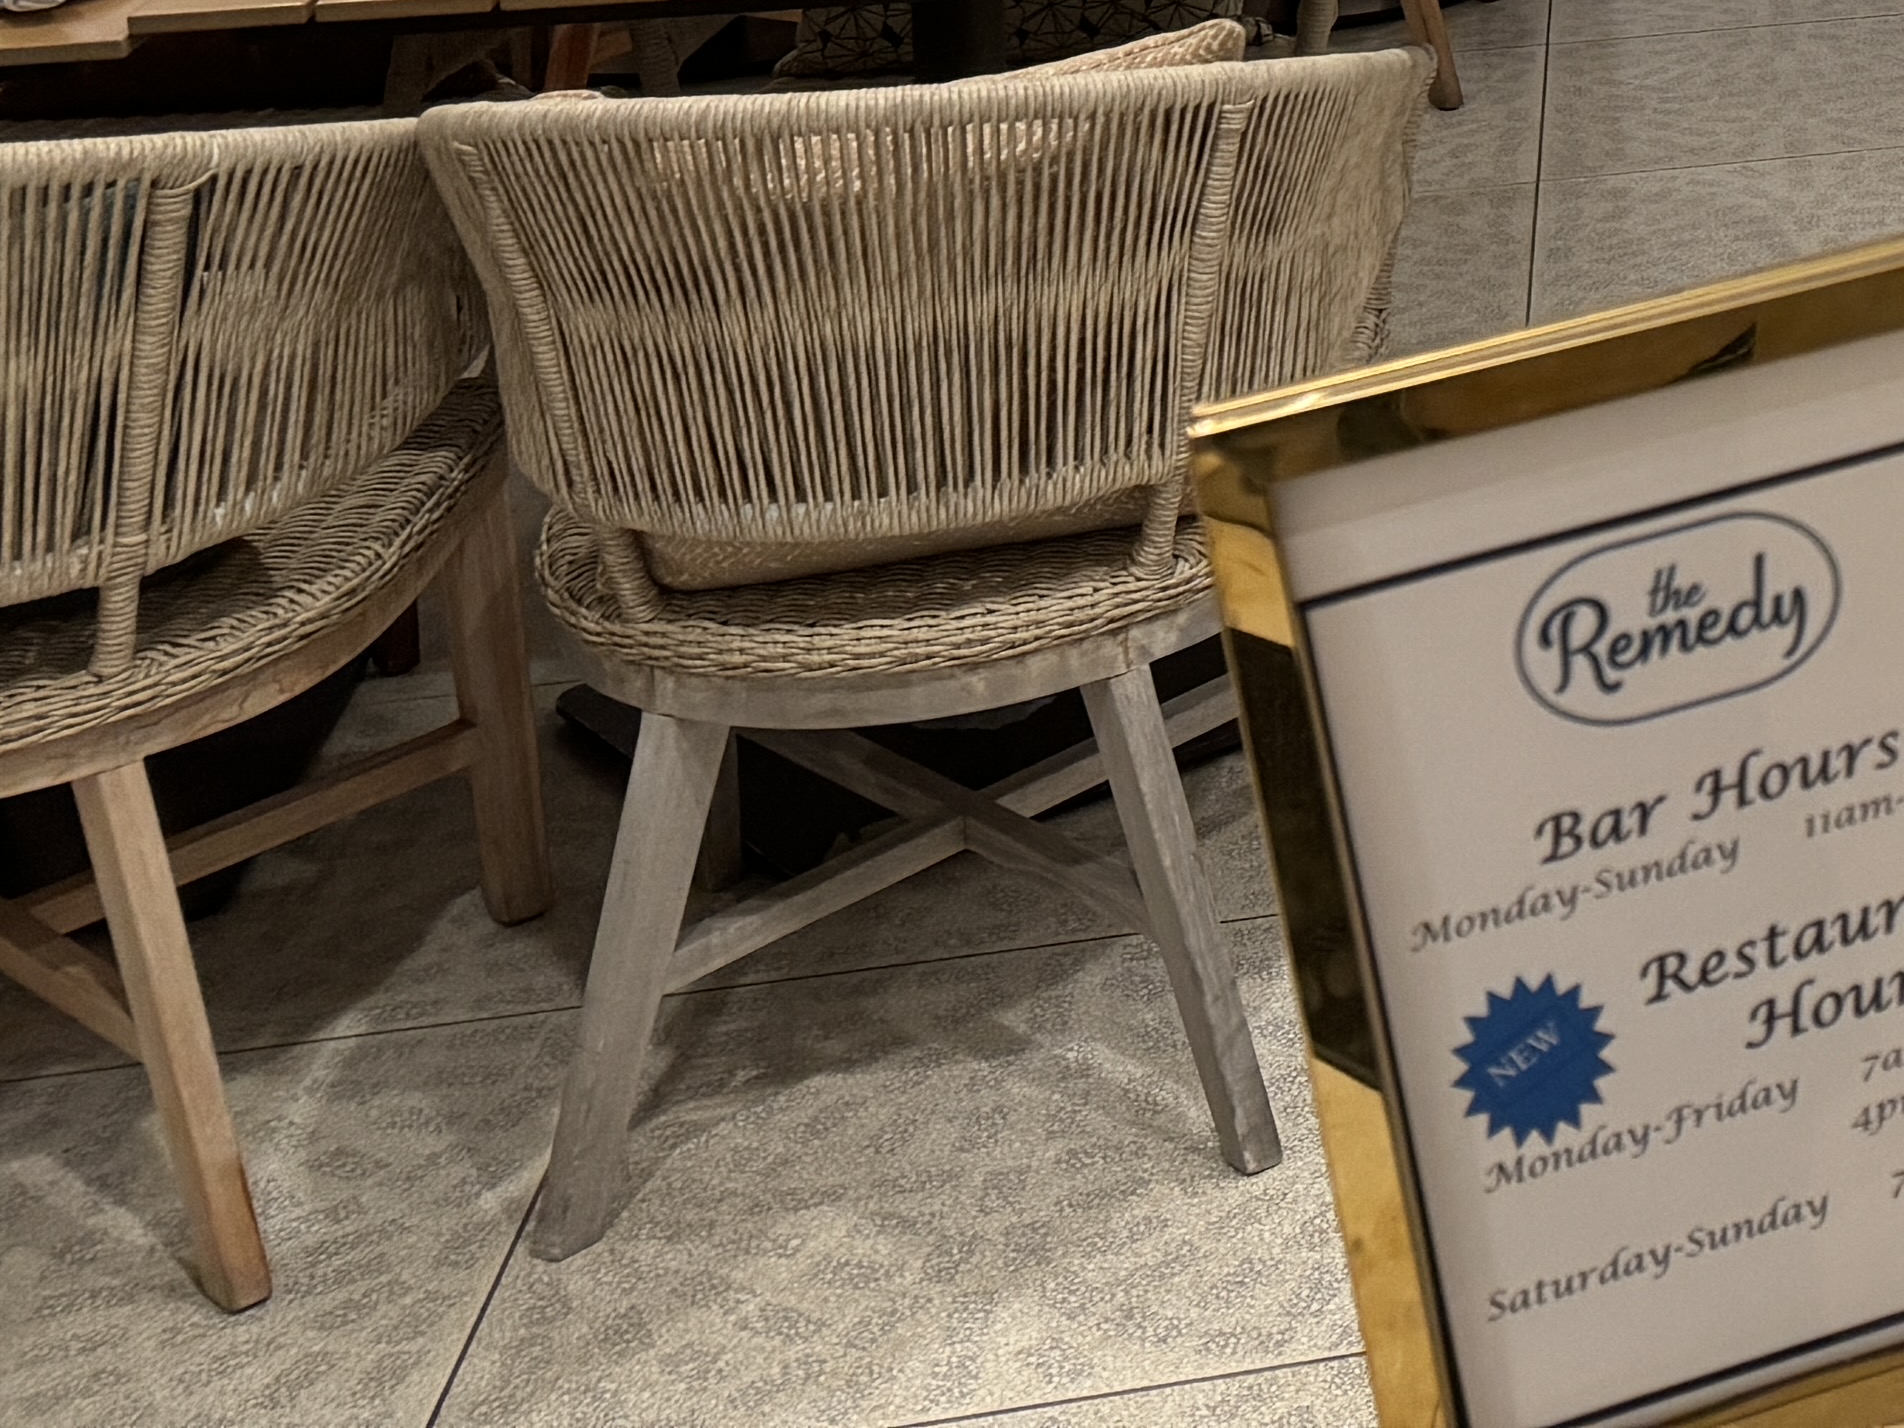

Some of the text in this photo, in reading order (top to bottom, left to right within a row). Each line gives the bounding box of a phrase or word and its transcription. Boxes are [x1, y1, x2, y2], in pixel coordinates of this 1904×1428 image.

[1538, 550, 1808, 695] Remedy
[1647, 561, 1706, 618] the
[1533, 728, 1902, 866] Bar Hours
[1409, 834, 1743, 954] Monday-Sunday
[1486, 1020, 1562, 1088] NEW
[1482, 1074, 1801, 1194] Monday-Friday
[1485, 1190, 1831, 1323] Saturday-Sunday
